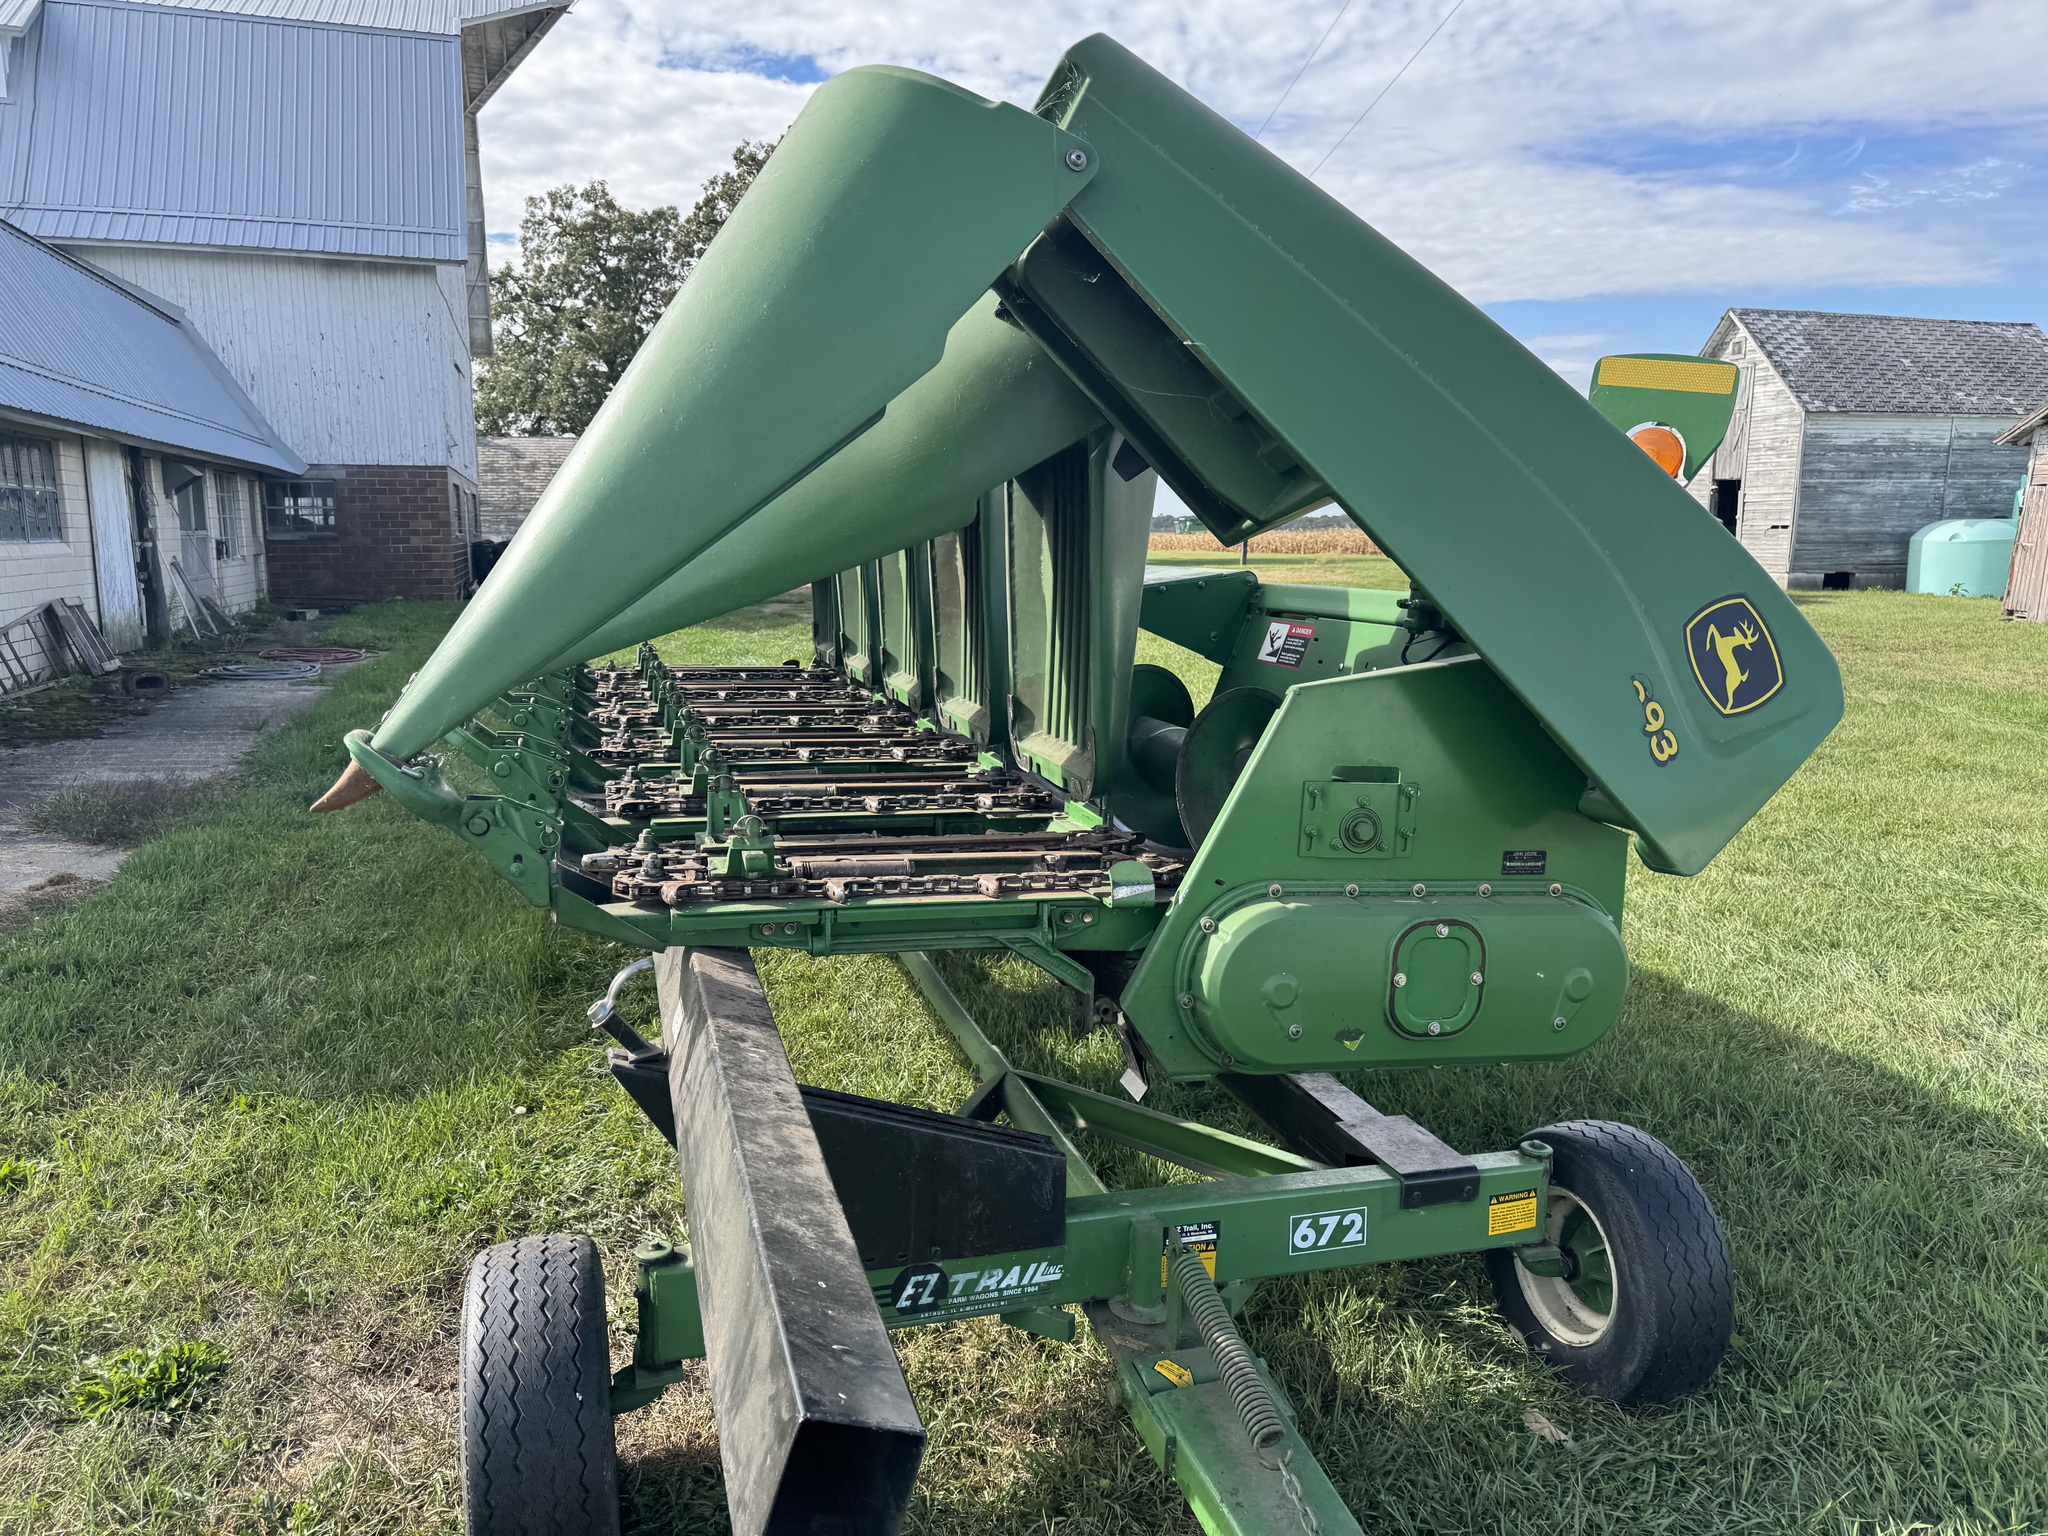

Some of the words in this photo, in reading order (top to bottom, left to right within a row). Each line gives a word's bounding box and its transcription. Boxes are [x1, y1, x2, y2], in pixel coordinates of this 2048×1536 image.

[1498, 1191, 1529, 1203] WARNING
[1201, 1222, 1214, 1230] Inc.
[1293, 1212, 1363, 1249] 672
[949, 1261, 1063, 1296] TRAIL
[1043, 1264, 1065, 1276] INC.
[948, 1296, 967, 1305] FARM
[969, 1291, 999, 1302] WAGONS
[1002, 1287, 1022, 1296] SINCE
